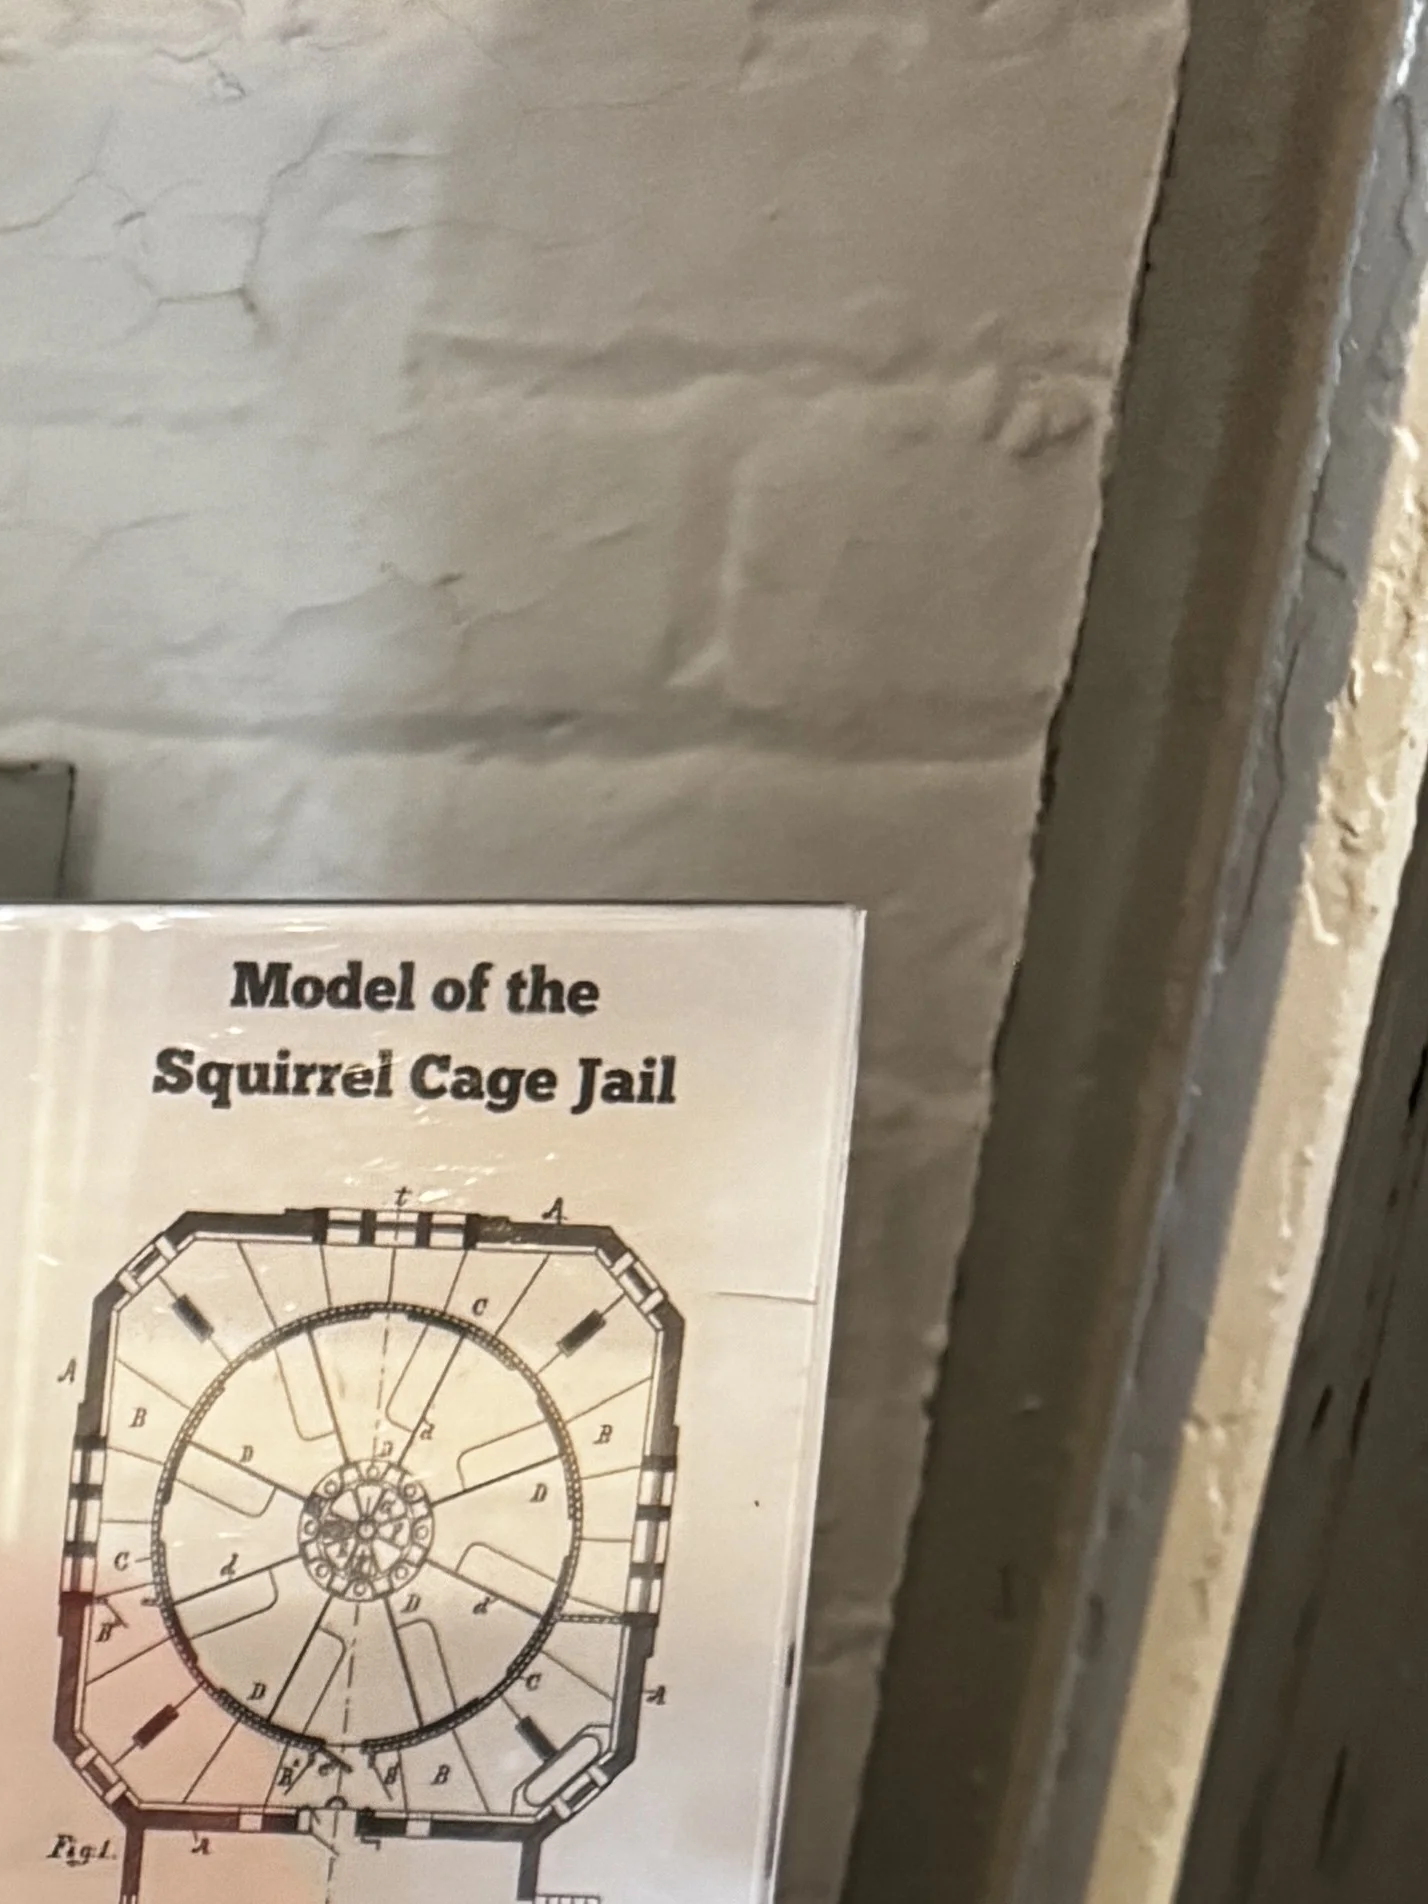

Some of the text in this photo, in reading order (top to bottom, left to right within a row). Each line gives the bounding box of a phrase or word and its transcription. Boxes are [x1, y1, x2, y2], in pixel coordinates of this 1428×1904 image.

[229, 960, 600, 1017] Model of the
[152, 1047, 677, 1115] Squirrel Cage Jail
[129, 1407, 147, 1427] B
